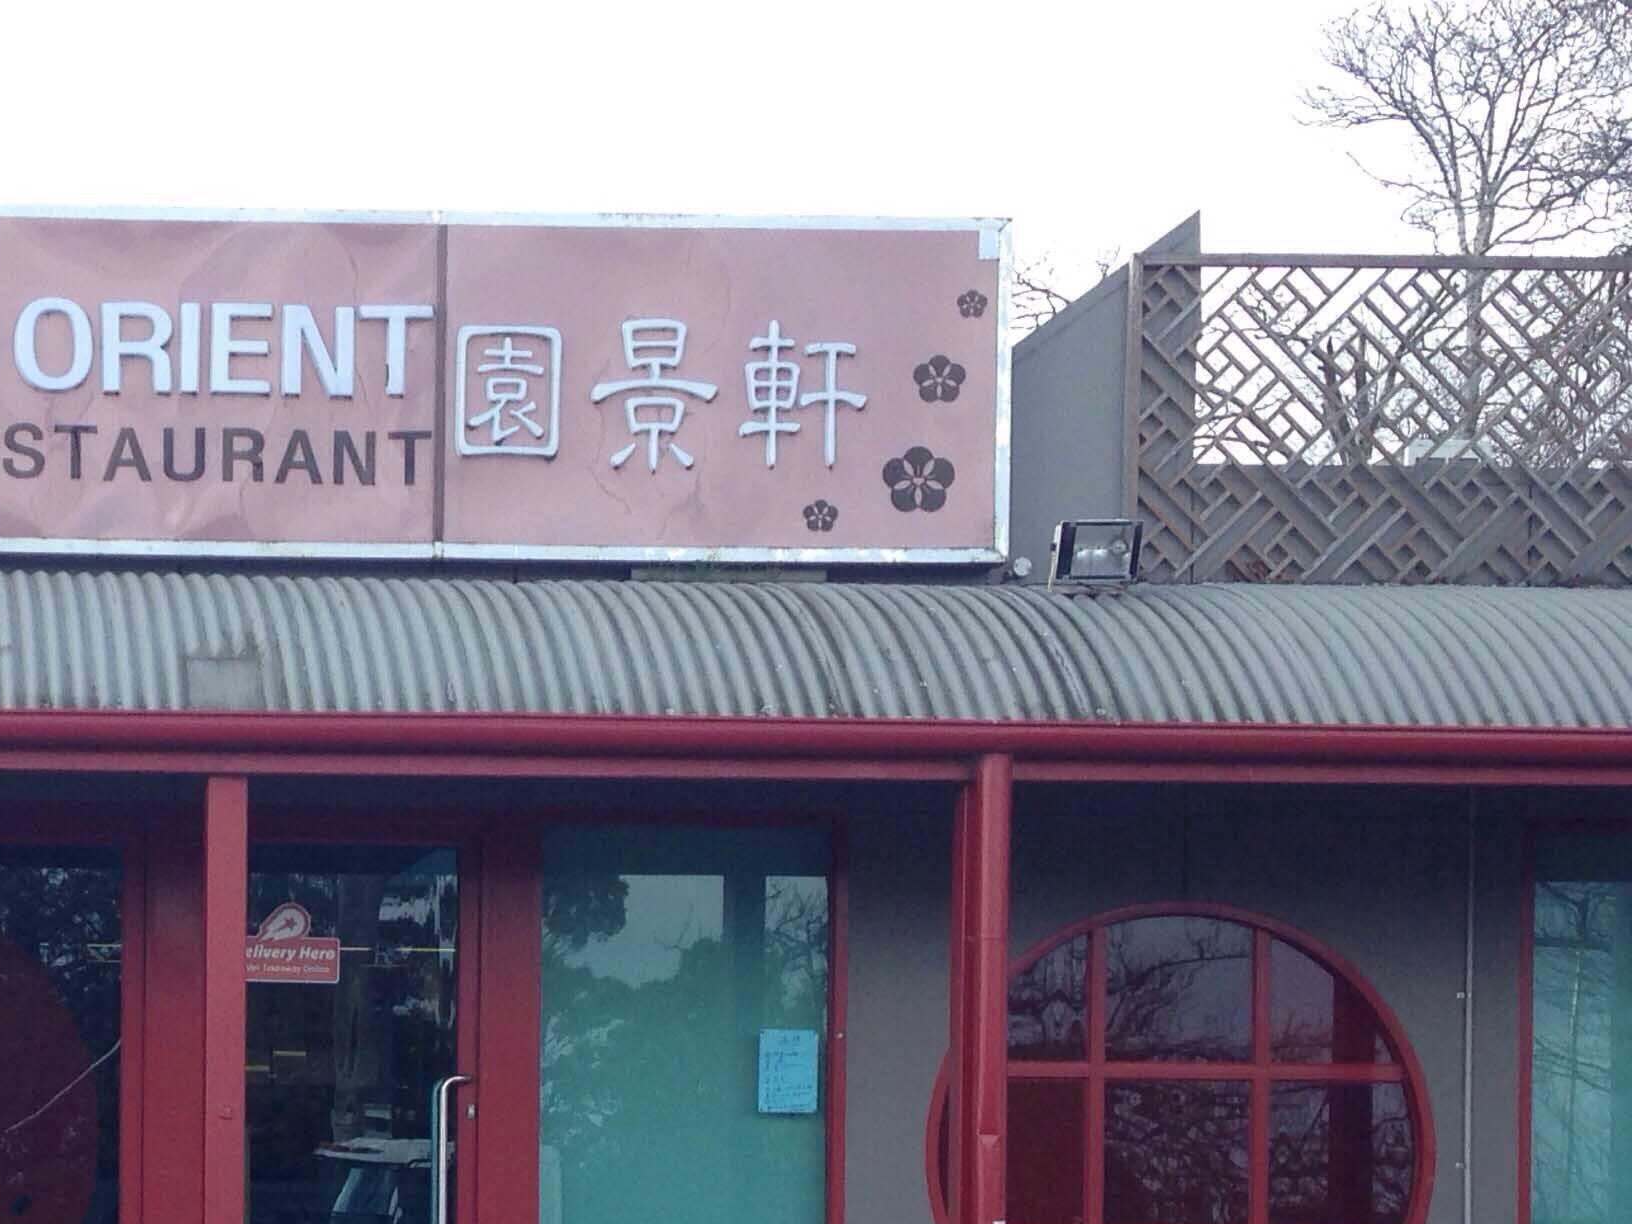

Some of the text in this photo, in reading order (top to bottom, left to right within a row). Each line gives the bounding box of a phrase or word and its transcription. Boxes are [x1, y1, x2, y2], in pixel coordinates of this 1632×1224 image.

[13, 297, 435, 400] ORIENT
[246, 944, 336, 962] elivery Hero
